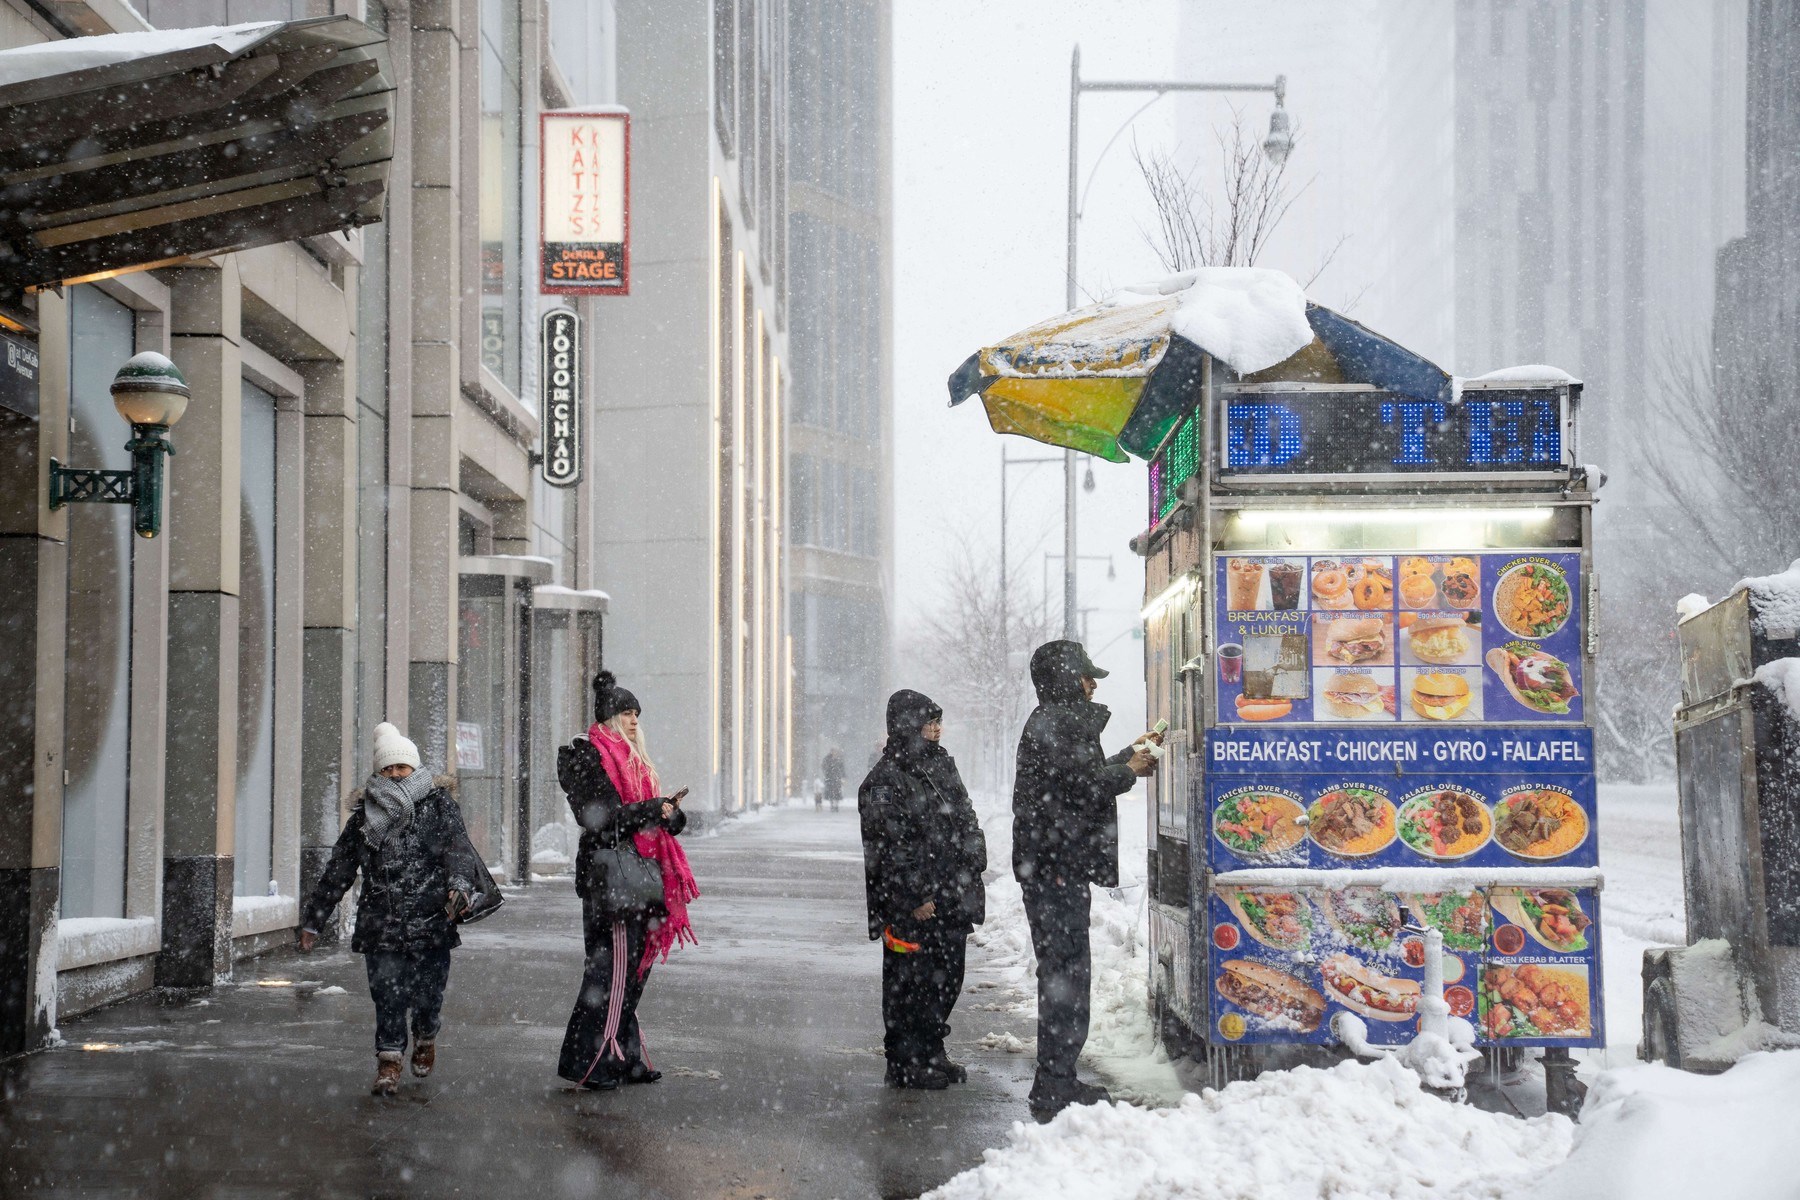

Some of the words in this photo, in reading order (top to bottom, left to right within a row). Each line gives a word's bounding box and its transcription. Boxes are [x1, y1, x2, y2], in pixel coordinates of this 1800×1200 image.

[568, 125, 585, 236] KATZ'S
[591, 128, 600, 233] KATZ'S
[552, 261, 616, 279] STAGE
[22, 349, 39, 368] DeKalb
[553, 319, 570, 387] FOGO
[16, 361, 33, 379] Avenue
[553, 389, 569, 401] DE
[1496, 557, 1527, 577] CHICKEN
[1529, 556, 1550, 565] OVER
[1550, 562, 1568, 577] RICE
[1228, 611, 1307, 622] BREAKFAST
[1320, 612, 1332, 620] Egg
[1342, 612, 1363, 620] Turkey
[1417, 612, 1429, 620] Egg
[1238, 624, 1247, 635] &
[1251, 625, 1297, 635] LUNCH
[1500, 640, 1521, 651] LAMB
[1522, 640, 1542, 650] GYRO
[1277, 653, 1298, 666] Bull
[1335, 667, 1348, 675] Egg
[1416, 667, 1429, 675] Egg
[1437, 667, 1467, 675] Sausage
[1213, 741, 1322, 761] BREAKFAST
[1336, 741, 1417, 761] CHICKEN
[1433, 740, 1487, 761] GYRO
[1502, 741, 1585, 761] FALAFEL
[1217, 785, 1255, 803] CHICKEN
[1257, 784, 1281, 794] OVER
[1282, 789, 1305, 803] RICE
[1317, 784, 1340, 797] LAMB
[1342, 782, 1366, 790] OVER
[1368, 784, 1389, 797] RICE
[1399, 784, 1436, 803] FALAFEL
[1438, 783, 1463, 792] OVER
[1464, 788, 1487, 803] RICE
[1501, 783, 1533, 797] COMBO
[1535, 783, 1573, 797] PLATTER
[1518, 956, 1547, 964] KEBAB
[1548, 956, 1586, 964] PLATTER
